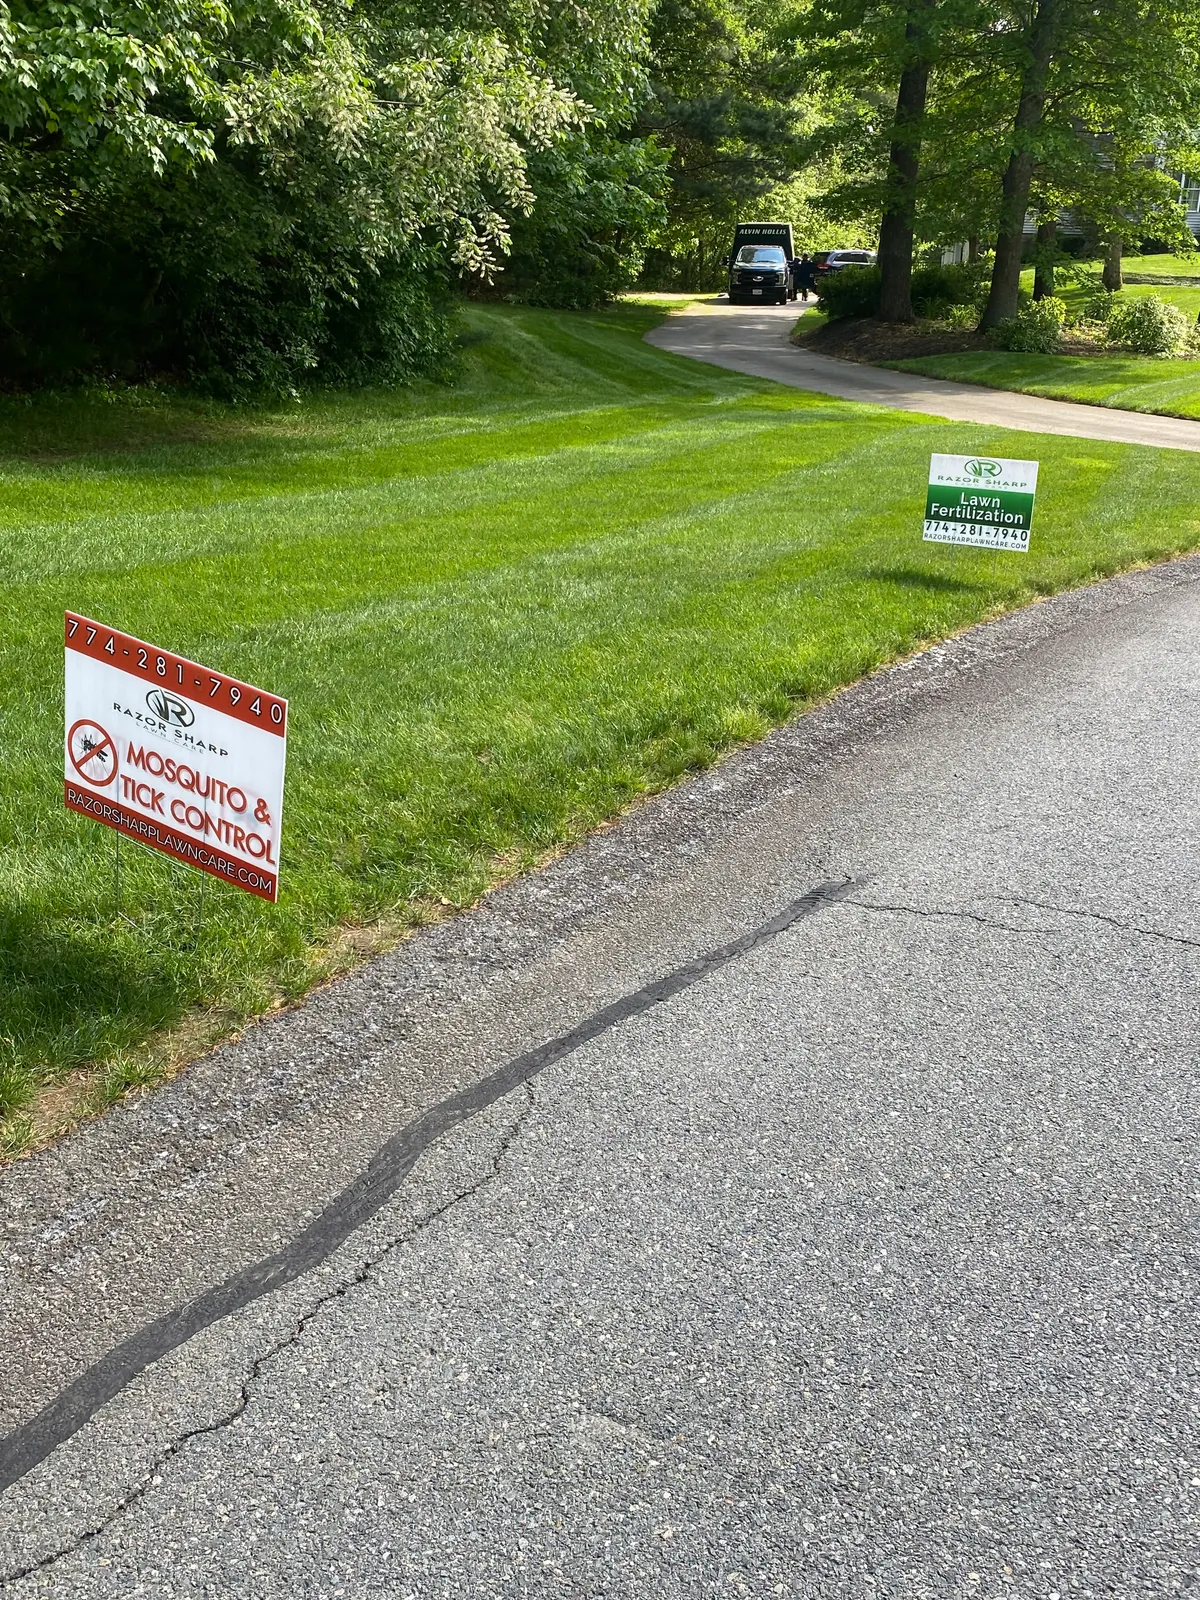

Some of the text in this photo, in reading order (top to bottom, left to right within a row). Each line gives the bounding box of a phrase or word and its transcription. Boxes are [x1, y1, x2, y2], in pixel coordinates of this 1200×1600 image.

[937, 475, 1027, 488] RAZOR SHARP
[930, 503, 1024, 525] Fertilization
[960, 492, 1001, 508] Lawn
[924, 532, 1027, 549] RAZORSHARPLAWNCARE.COM
[925, 520, 1028, 541] 774-281-7940
[67, 619, 283, 724] 774-281-7940
[113, 702, 229, 757] RAZOR SHARP
[136, 722, 204, 755] LAWN CARE
[126, 741, 272, 826] MOSQUITO &
[120, 774, 276, 865] TICK CONTROL
[67, 788, 272, 894] RAZORSHARPLAWNCARE.COM
